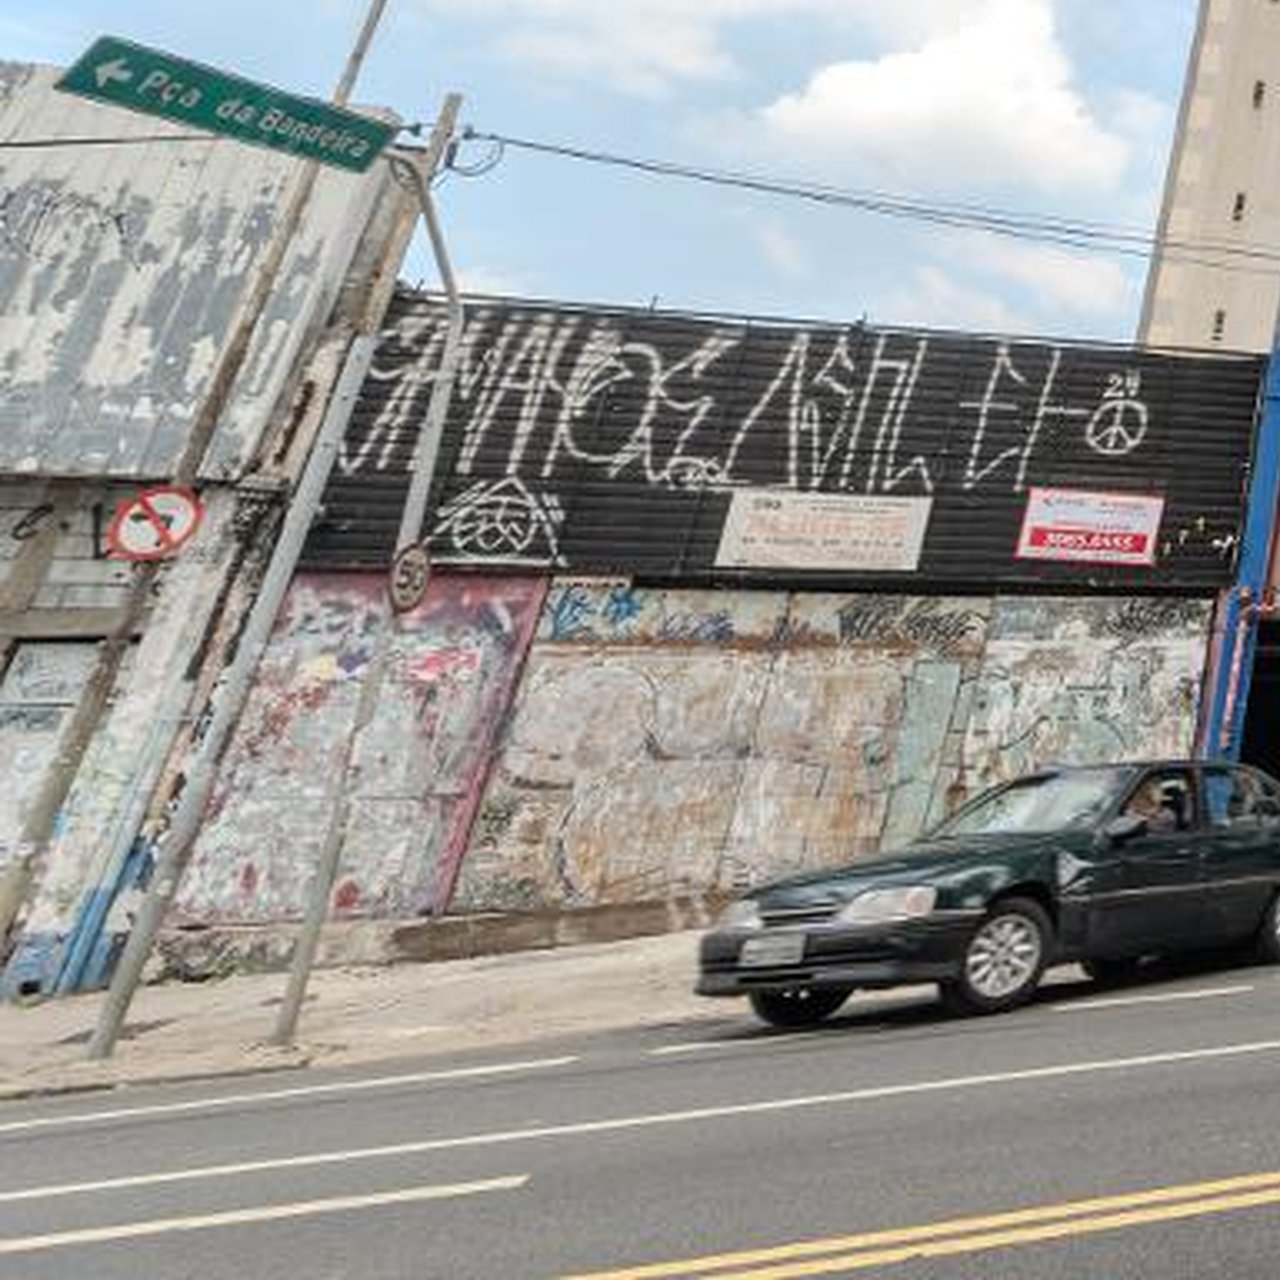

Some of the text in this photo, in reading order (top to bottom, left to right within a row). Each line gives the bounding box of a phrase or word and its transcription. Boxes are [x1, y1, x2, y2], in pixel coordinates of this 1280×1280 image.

[137, 70, 371, 158] Pça da Bandeira
